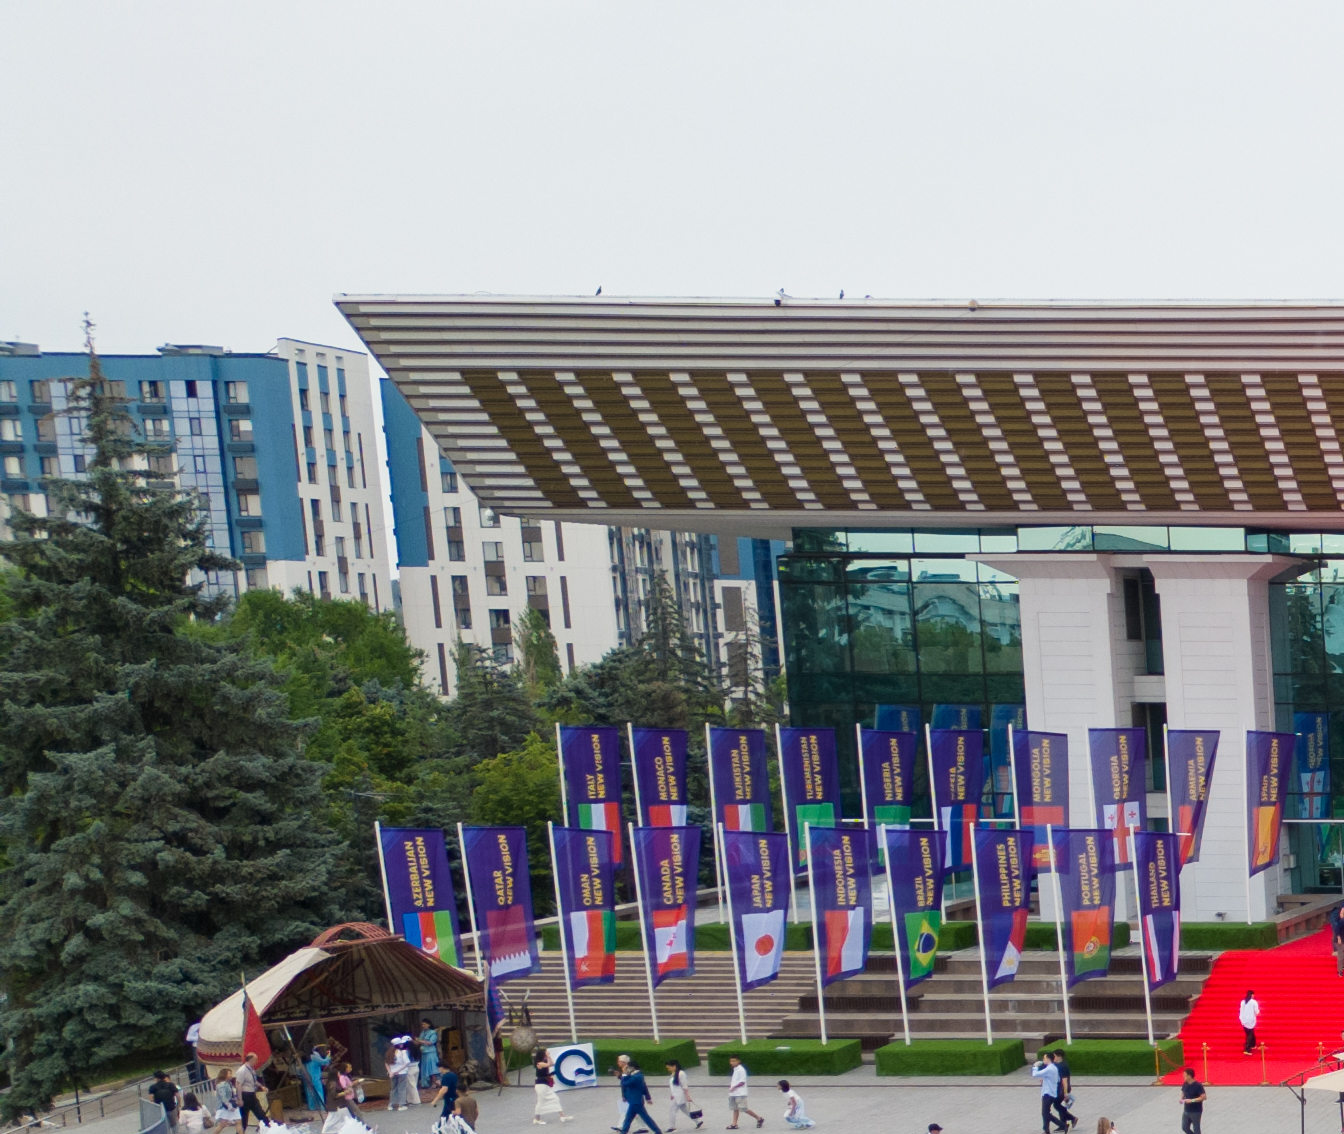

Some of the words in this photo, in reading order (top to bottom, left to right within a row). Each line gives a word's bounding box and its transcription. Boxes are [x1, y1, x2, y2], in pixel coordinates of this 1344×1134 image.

[591, 734, 603, 771] VISION
[662, 736, 674, 773] VISION
[739, 736, 751, 772] VISION
[810, 735, 821, 772] VISION
[890, 738, 901, 774] VISION
[957, 737, 965, 772] VISION
[1042, 739, 1050, 775] VISION
[1119, 736, 1128, 772] VISION
[1196, 737, 1205, 774] VISION
[1270, 739, 1278, 774] VISION
[586, 774, 596, 798] ITALY
[596, 773, 606, 798] NEW
[654, 757, 668, 800] MONACO
[668, 776, 678, 800] NEW
[814, 774, 822, 800] NEW
[882, 762, 894, 800] NIGERIA
[894, 776, 903, 800] NEW
[957, 776, 966, 800] NEW
[1043, 777, 1052, 802] NEW
[1110, 756, 1120, 800] GEORGIA
[1188, 760, 1197, 801] ARMENIA
[1270, 777, 1278, 801] NEW
[415, 836, 430, 877] VISION
[498, 835, 512, 874] VISION
[586, 837, 600, 876] VISION
[670, 834, 683, 874] VISION
[759, 840, 771, 878] VISION
[842, 836, 854, 875] VISION
[920, 838, 933, 876] VISION
[1007, 837, 1020, 876] VISION
[1086, 836, 1098, 876] VISION
[1156, 840, 1168, 877] VISION
[404, 841, 424, 907] AZERBAIJAN
[493, 870, 504, 905] QATAR
[580, 874, 592, 905] OMAN
[592, 878, 602, 904] NEW
[660, 860, 674, 904] CANADA
[674, 876, 684, 904] NEW
[751, 875, 762, 908] JAPAN
[833, 849, 846, 905] INDONESIA
[847, 877, 856, 905] NEW
[914, 876, 926, 906] BRAZIL
[1078, 853, 1091, 905] PORTUGAL
[1092, 877, 1100, 904] NEW
[423, 879, 434, 906] NEW
[1160, 880, 1171, 906] NEW
